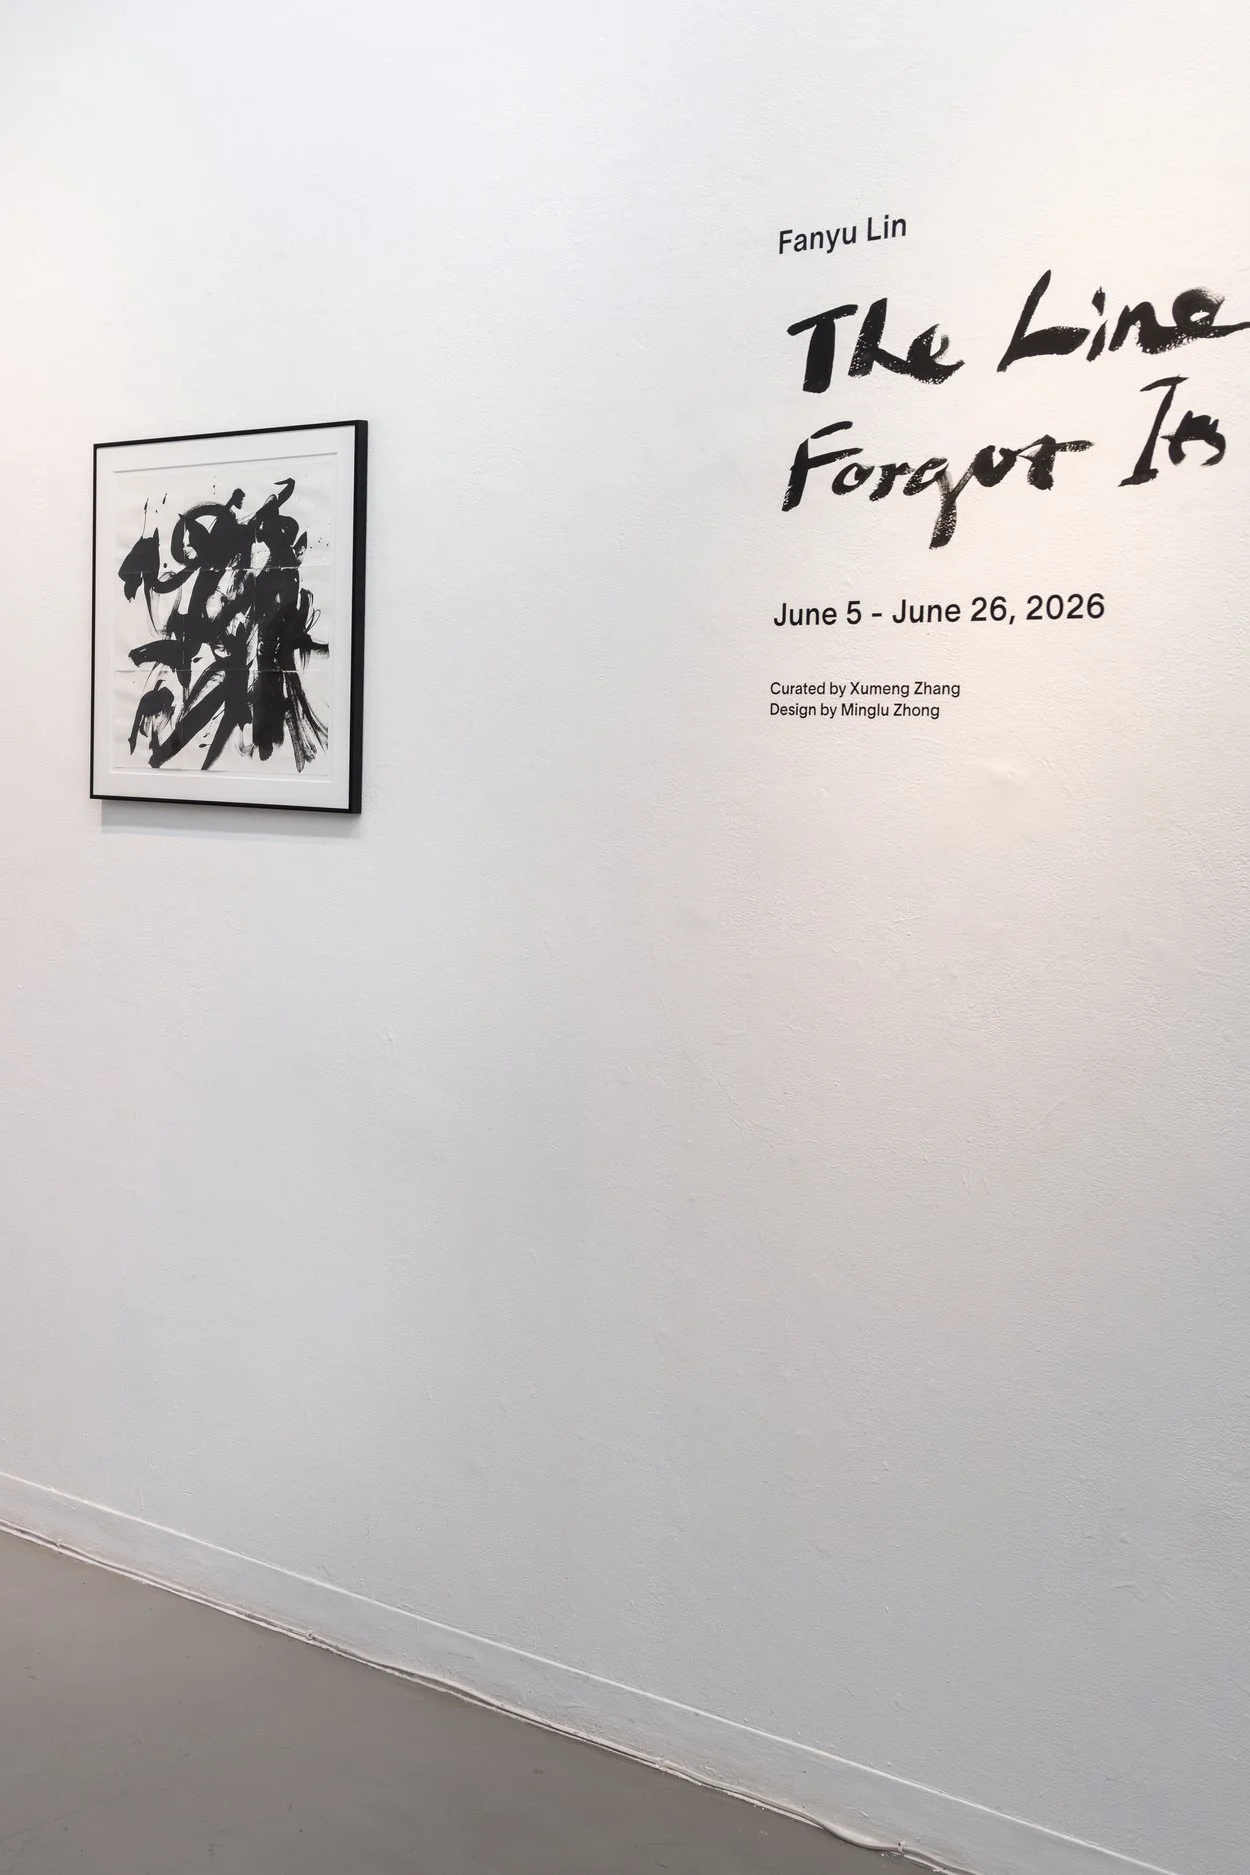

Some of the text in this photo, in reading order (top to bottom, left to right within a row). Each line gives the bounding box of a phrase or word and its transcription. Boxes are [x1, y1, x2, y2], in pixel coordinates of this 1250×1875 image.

[778, 214, 907, 255] Fanyu Lin
[786, 269, 1250, 393] The Line
[781, 420, 1094, 550] Forgot
[773, 602, 838, 627] June
[846, 600, 862, 625] 5
[892, 599, 961, 624] June
[970, 595, 1016, 625] 26,
[1026, 592, 1105, 621] 2026
[770, 681, 961, 698] Curated by Xumeng Zhang
[770, 702, 940, 720] Design by Minglu Zhong
